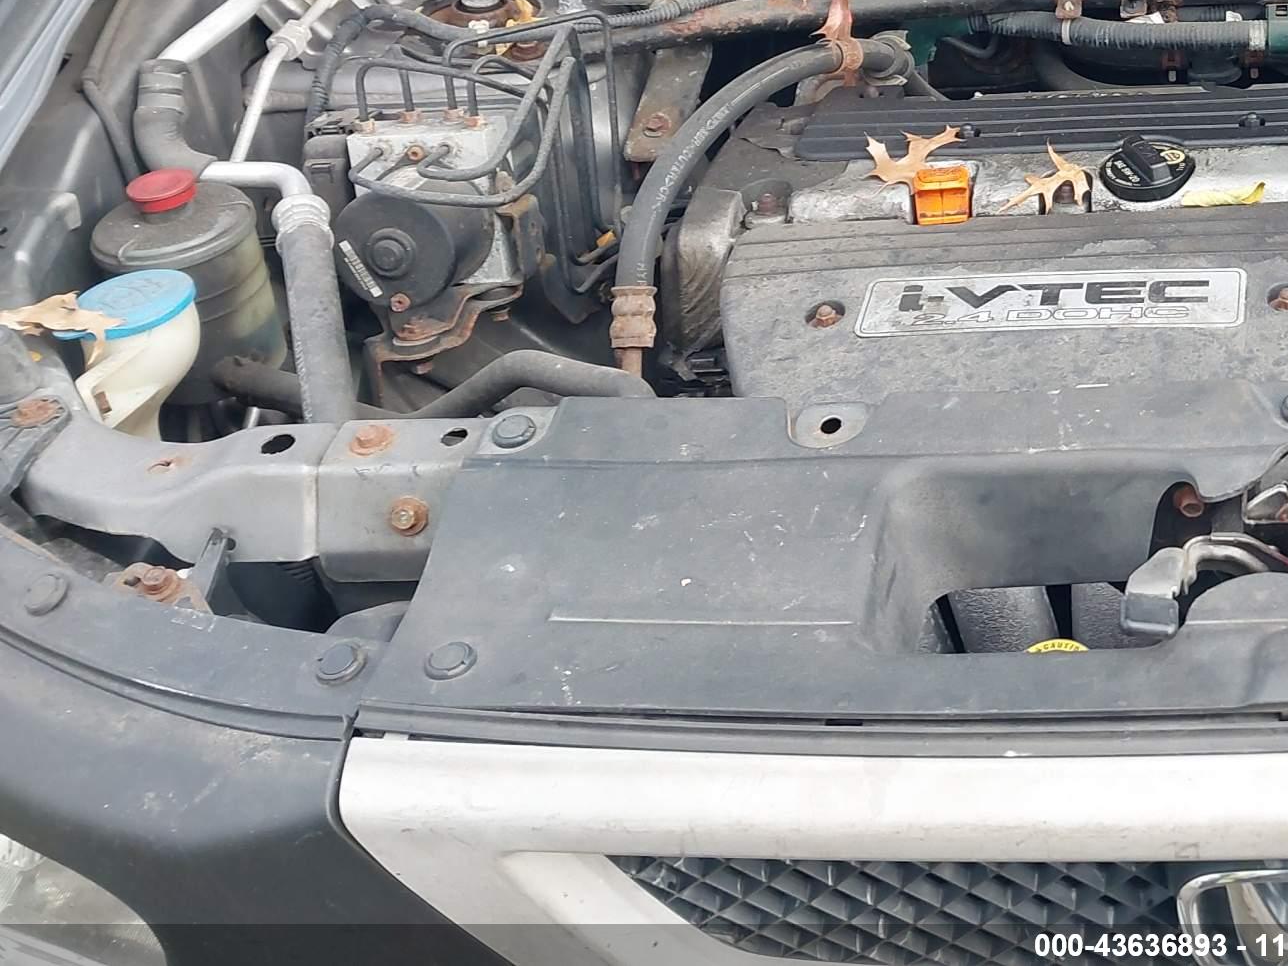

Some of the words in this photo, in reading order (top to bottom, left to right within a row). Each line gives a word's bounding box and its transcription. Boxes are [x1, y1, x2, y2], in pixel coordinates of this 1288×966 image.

[899, 280, 1209, 312] i-VTEC
[911, 311, 994, 326] 2.4
[1005, 306, 1189, 322] DOHC
